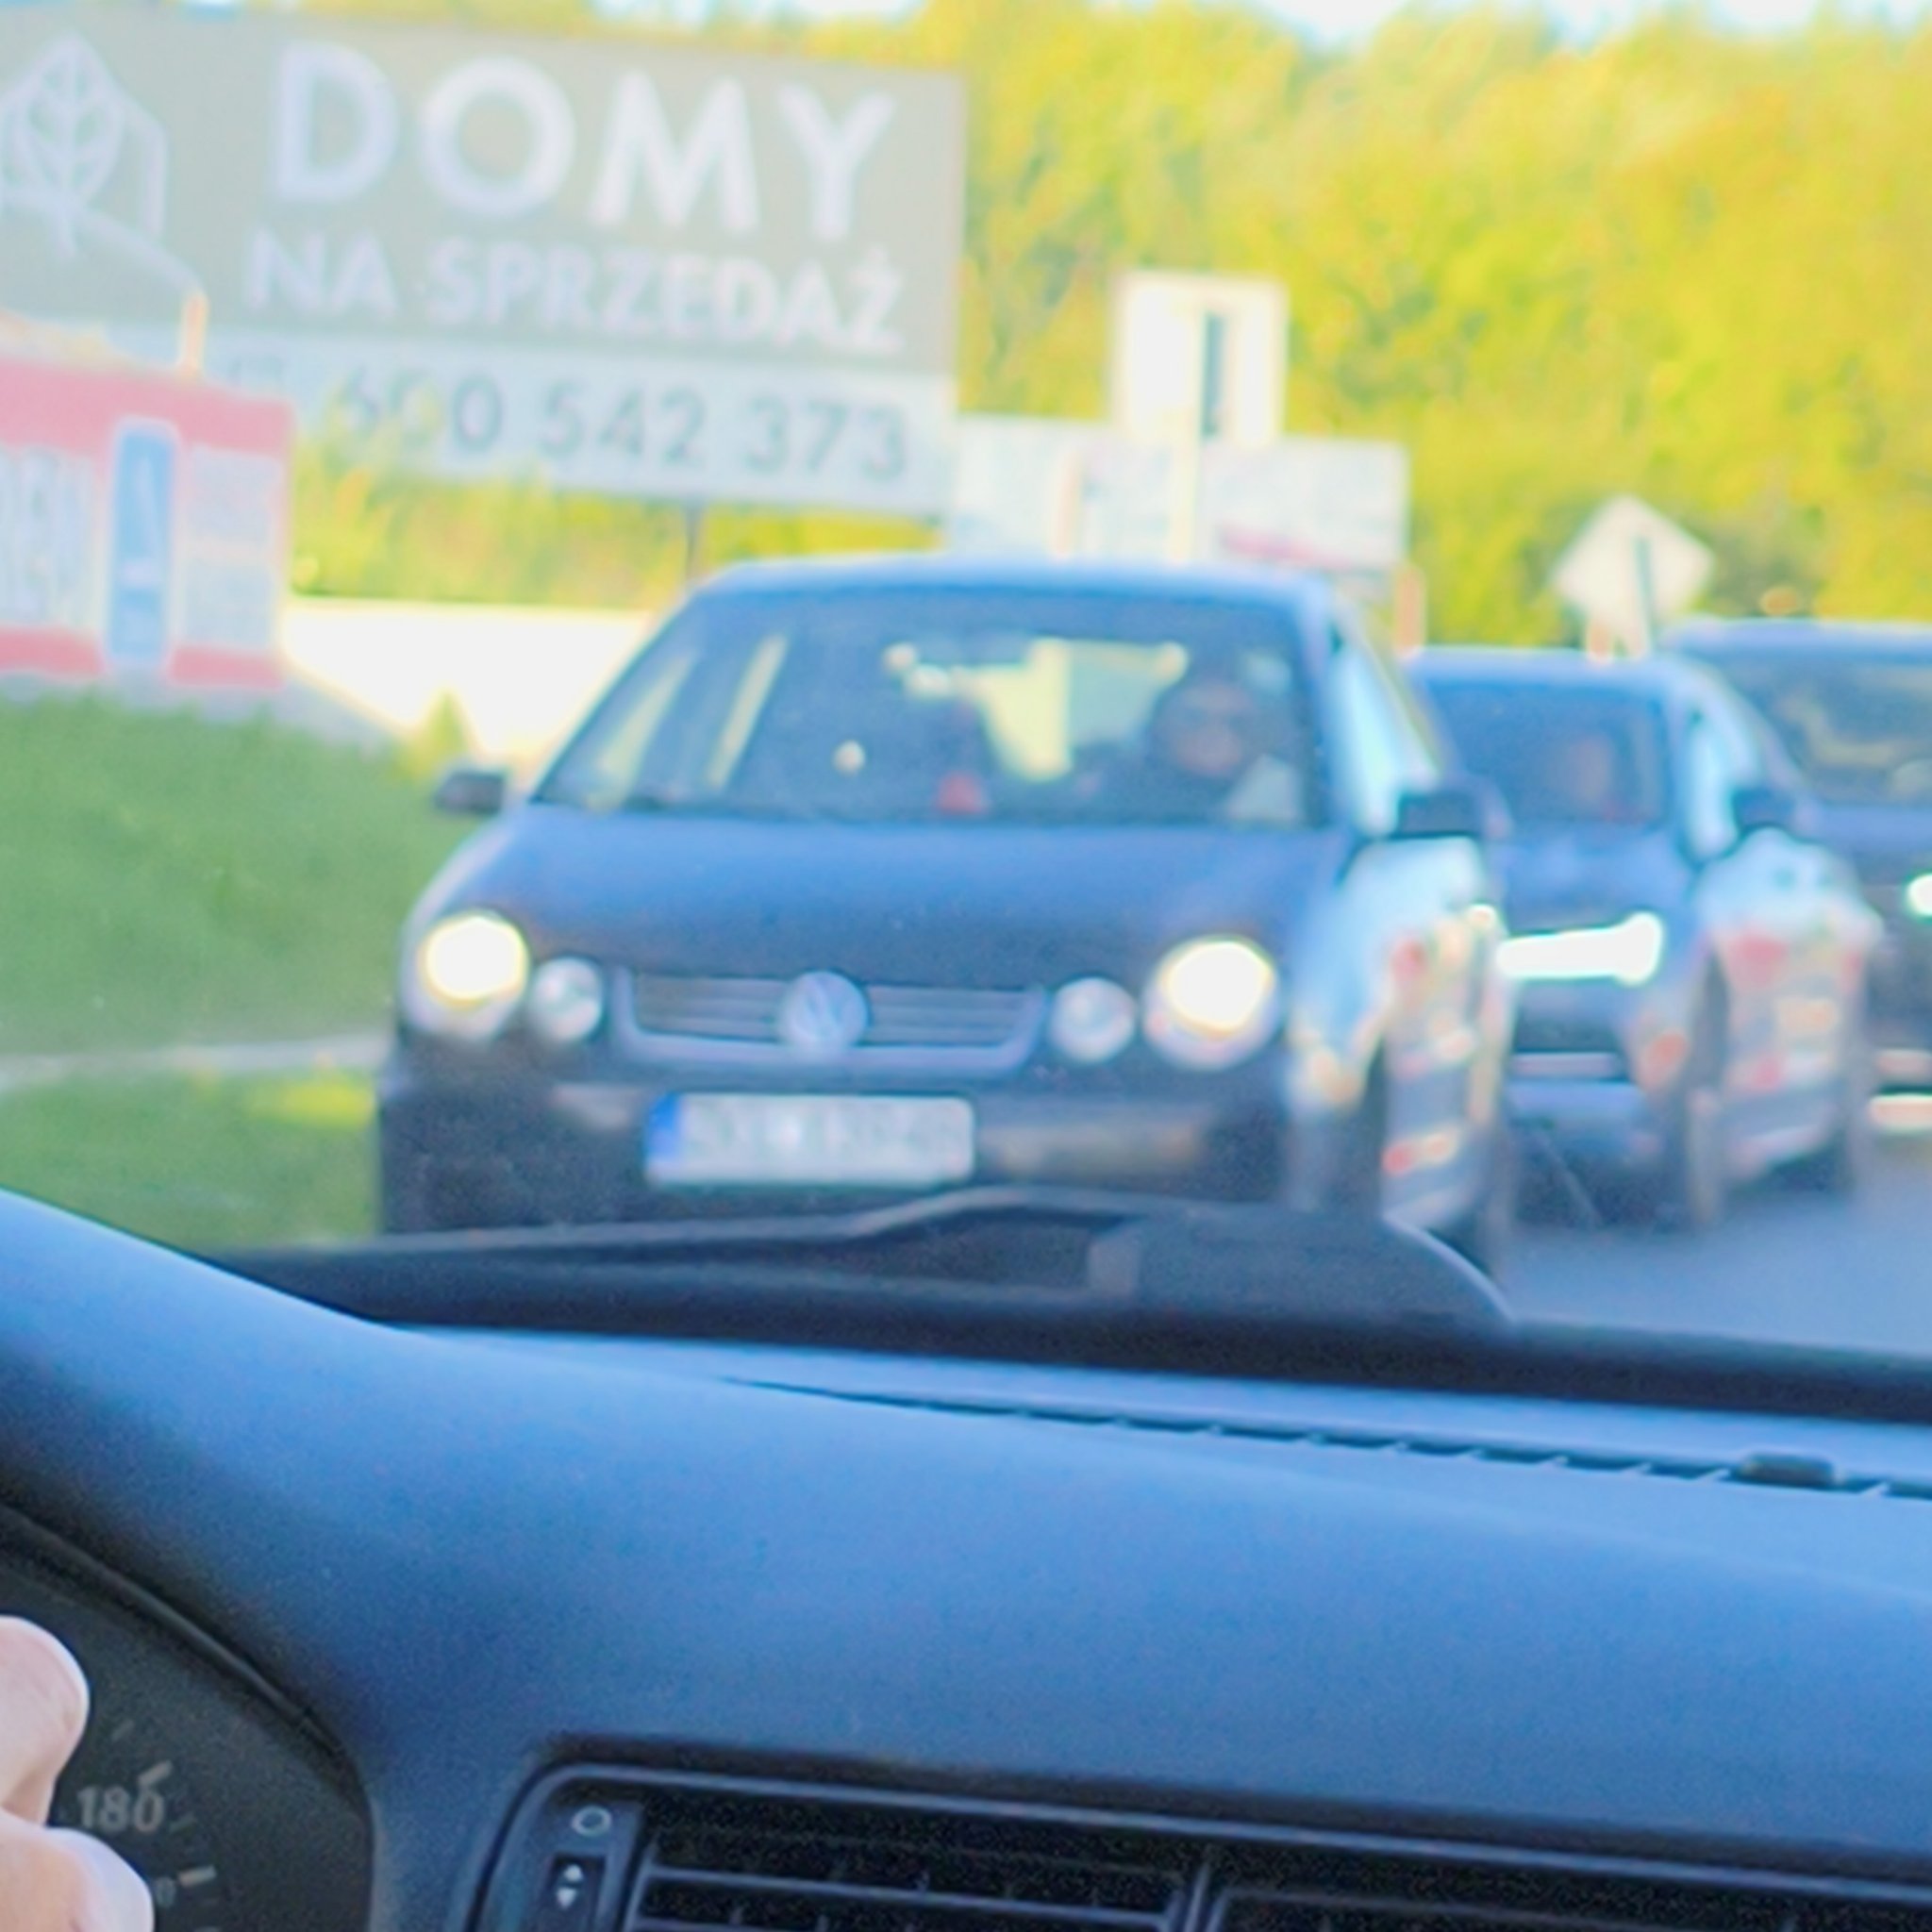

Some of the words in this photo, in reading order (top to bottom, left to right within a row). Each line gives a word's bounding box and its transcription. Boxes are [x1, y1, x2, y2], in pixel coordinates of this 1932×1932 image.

[275, 42, 898, 240] DOMY
[244, 229, 397, 316] NA
[427, 236, 903, 355] SPRZEDAŻ
[536, 375, 708, 468] 542
[744, 396, 908, 481] 373
[78, 1786, 165, 1833] 180
